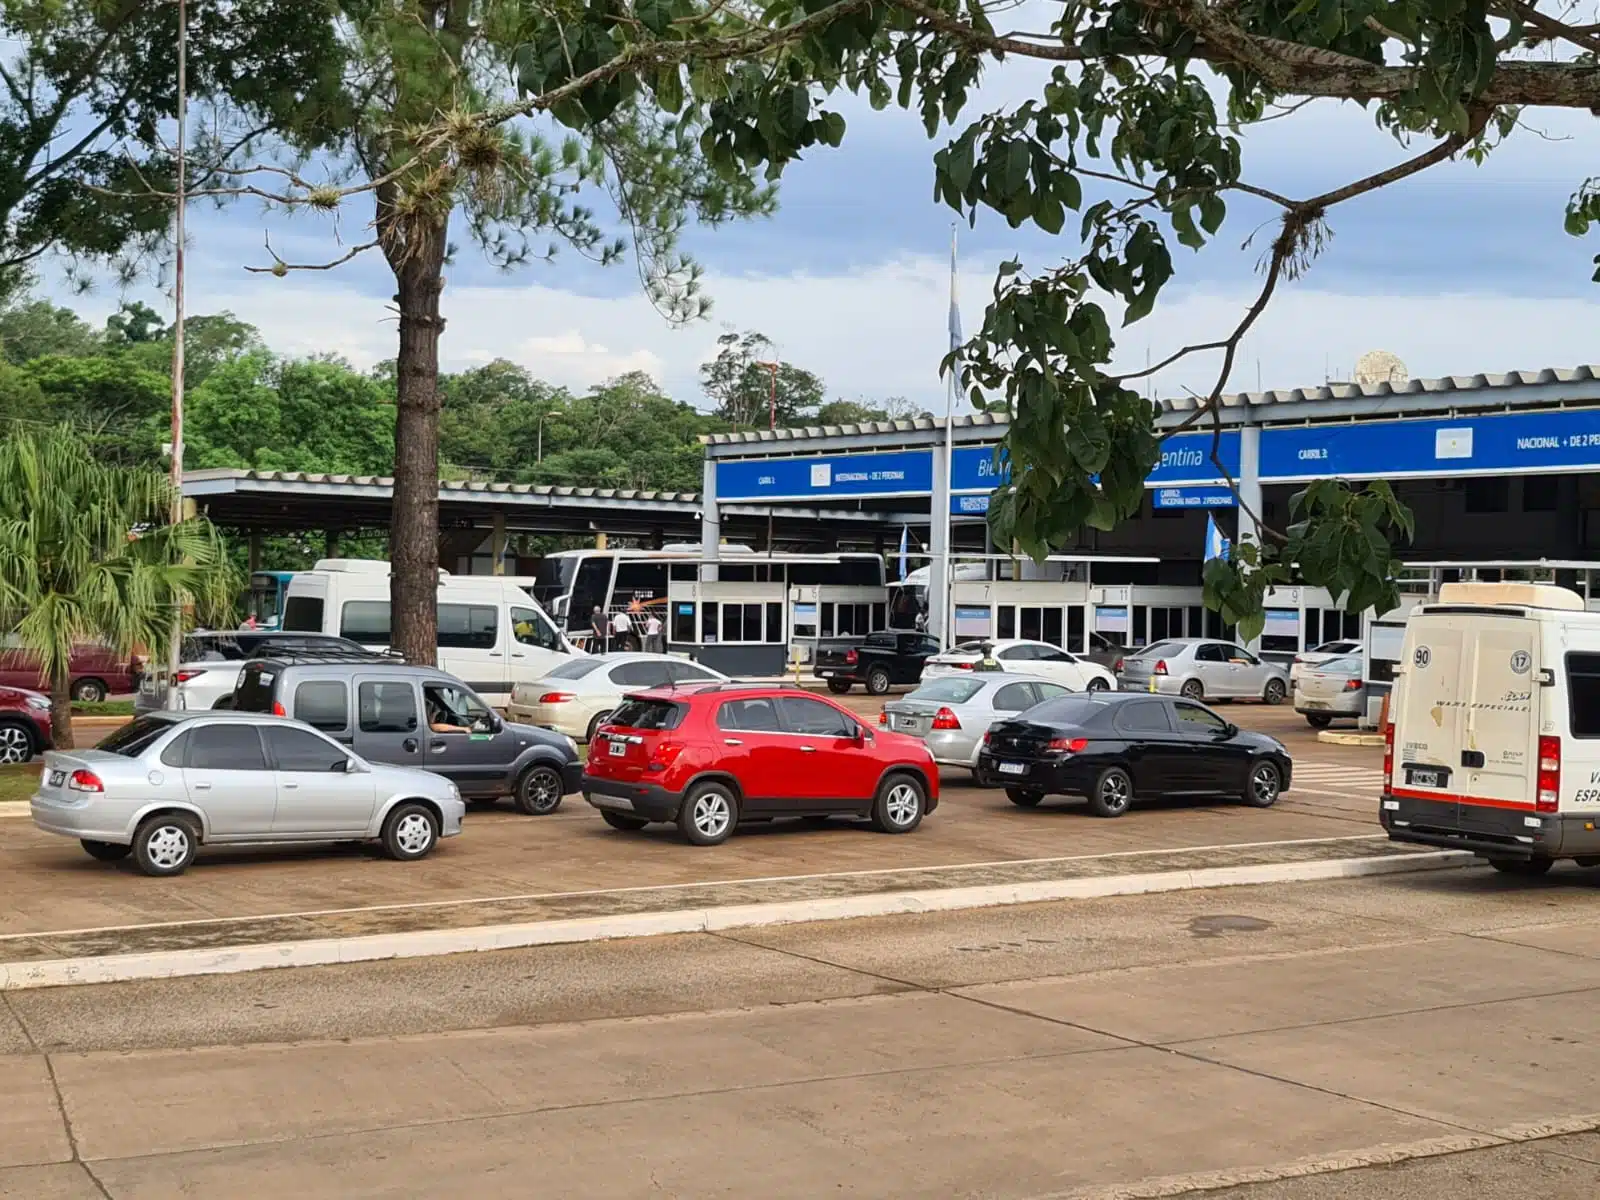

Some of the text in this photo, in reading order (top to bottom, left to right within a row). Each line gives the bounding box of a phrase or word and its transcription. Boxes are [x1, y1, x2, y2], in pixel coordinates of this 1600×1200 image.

[1516, 436, 1560, 450] NACIONAL
[1569, 435, 1581, 447] DE
[1581, 434, 1588, 447] 2
[984, 585, 990, 600] 7
[1415, 650, 1429, 665] 90
[1514, 656, 1527, 668] 17
